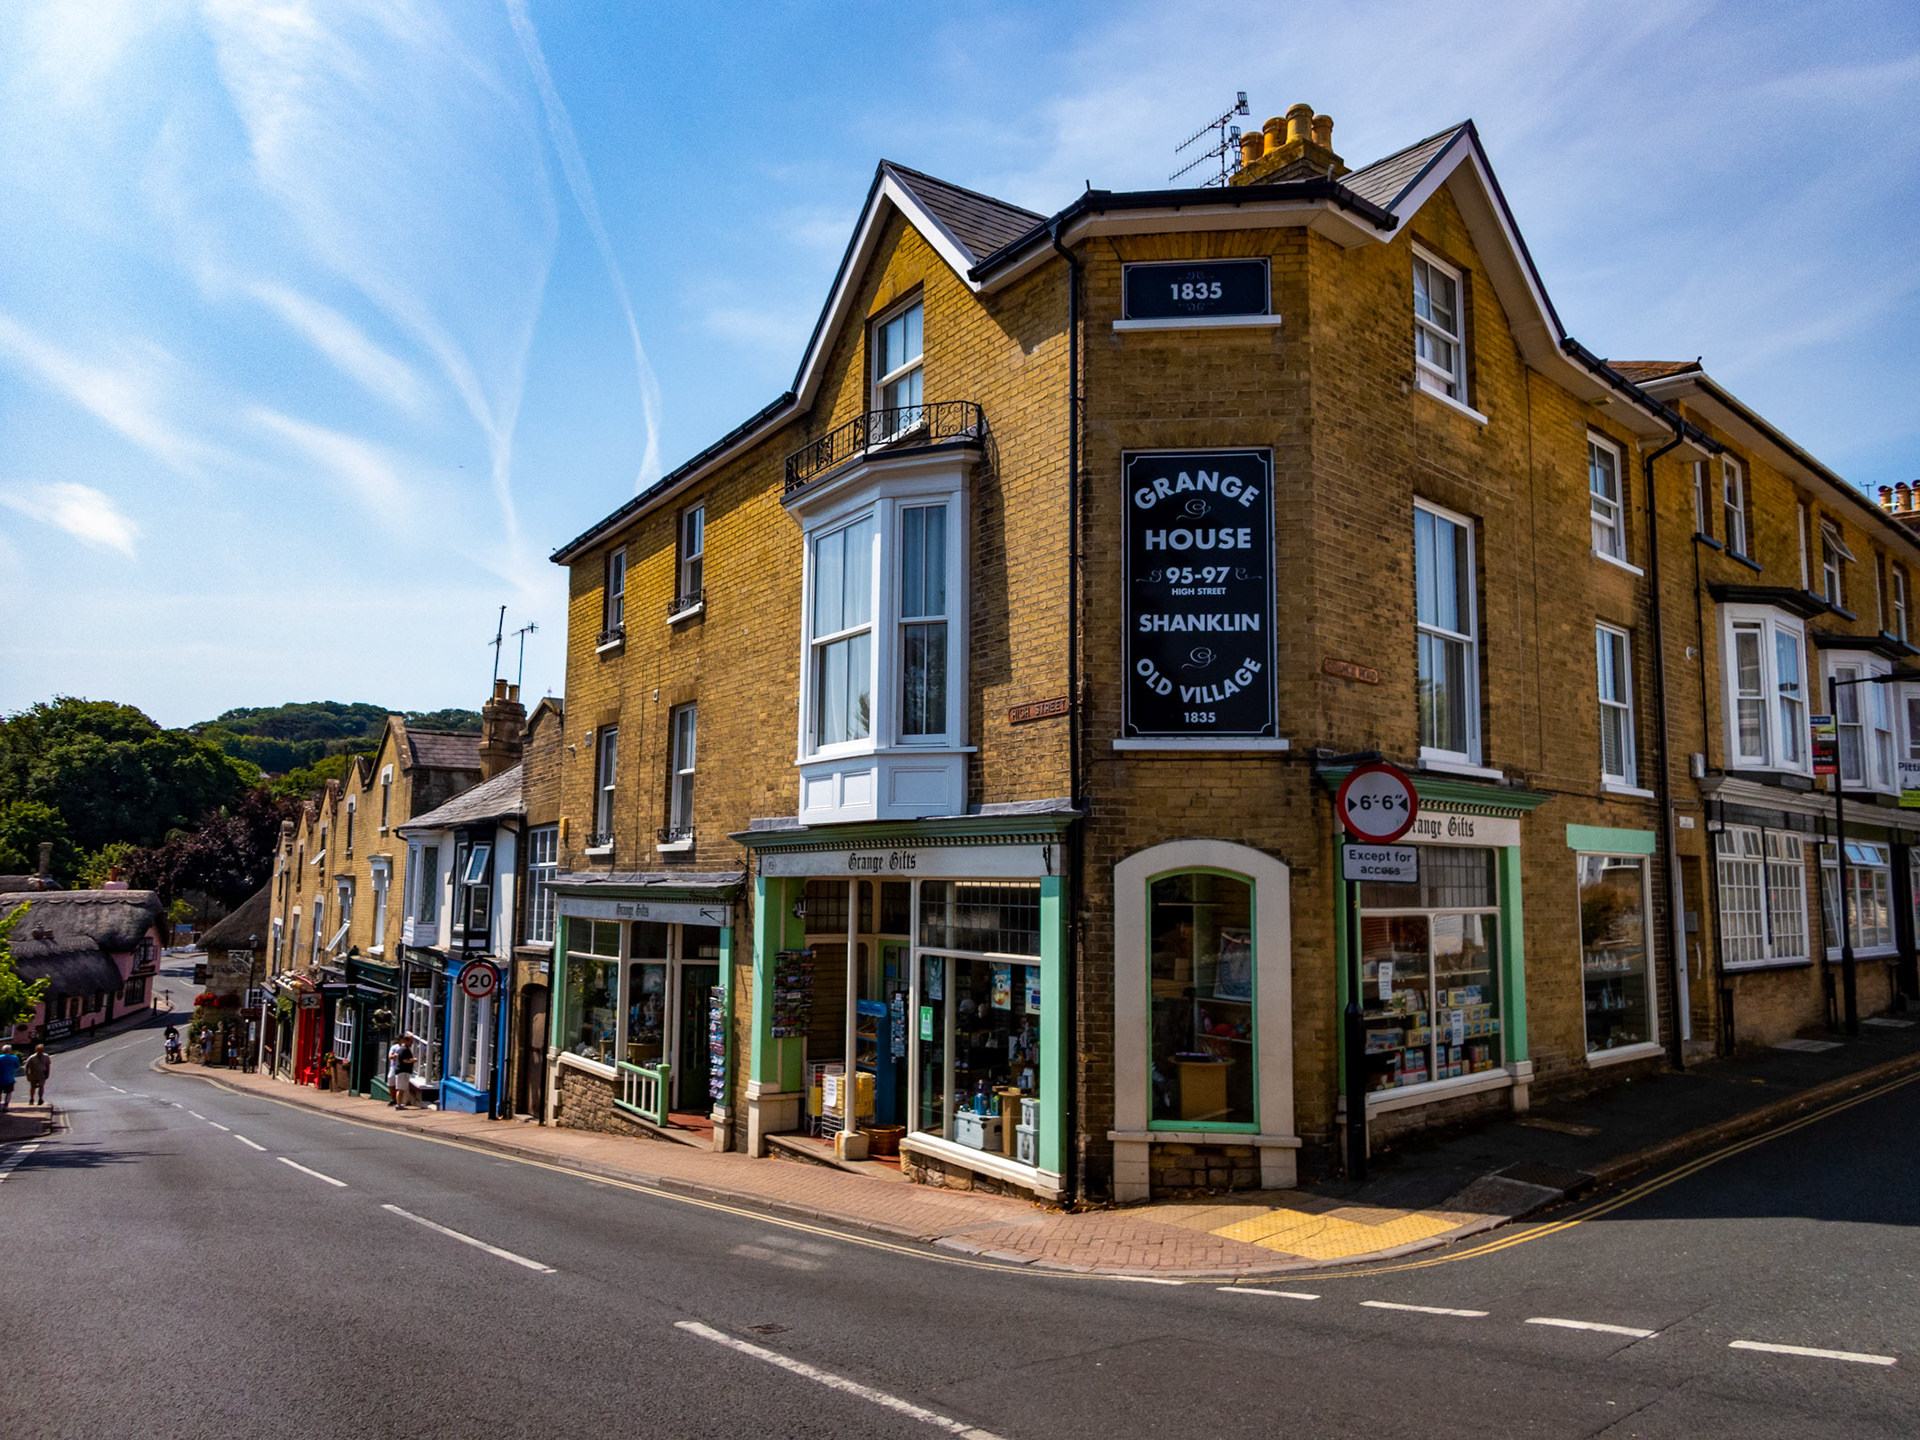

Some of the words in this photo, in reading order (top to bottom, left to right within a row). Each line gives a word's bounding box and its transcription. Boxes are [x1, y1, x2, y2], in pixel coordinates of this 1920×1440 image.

[1170, 282, 1223, 300] 1835
[1134, 470, 1260, 509] GRANGE
[1145, 527, 1251, 550] HOUSE
[1166, 566, 1231, 584] 95-97
[1171, 588, 1195, 596] HIGH
[1197, 587, 1227, 595] STREET
[1139, 613, 1260, 632] SHANKLIN
[1136, 658, 1173, 696] OLD
[1179, 657, 1262, 704] VILLAGE
[1012, 707, 1031, 721] HIGH
[1034, 699, 1066, 716] STREET
[1183, 712, 1216, 723] 1835
[1412, 818, 1442, 839] range
[1447, 816, 1474, 838] Gifts
[848, 852, 884, 874] Grange
[889, 851, 917, 871] Gifts
[1349, 849, 1391, 864] Except
[1394, 851, 1412, 863] for
[1360, 864, 1401, 876] access
[468, 974, 492, 988] 20
